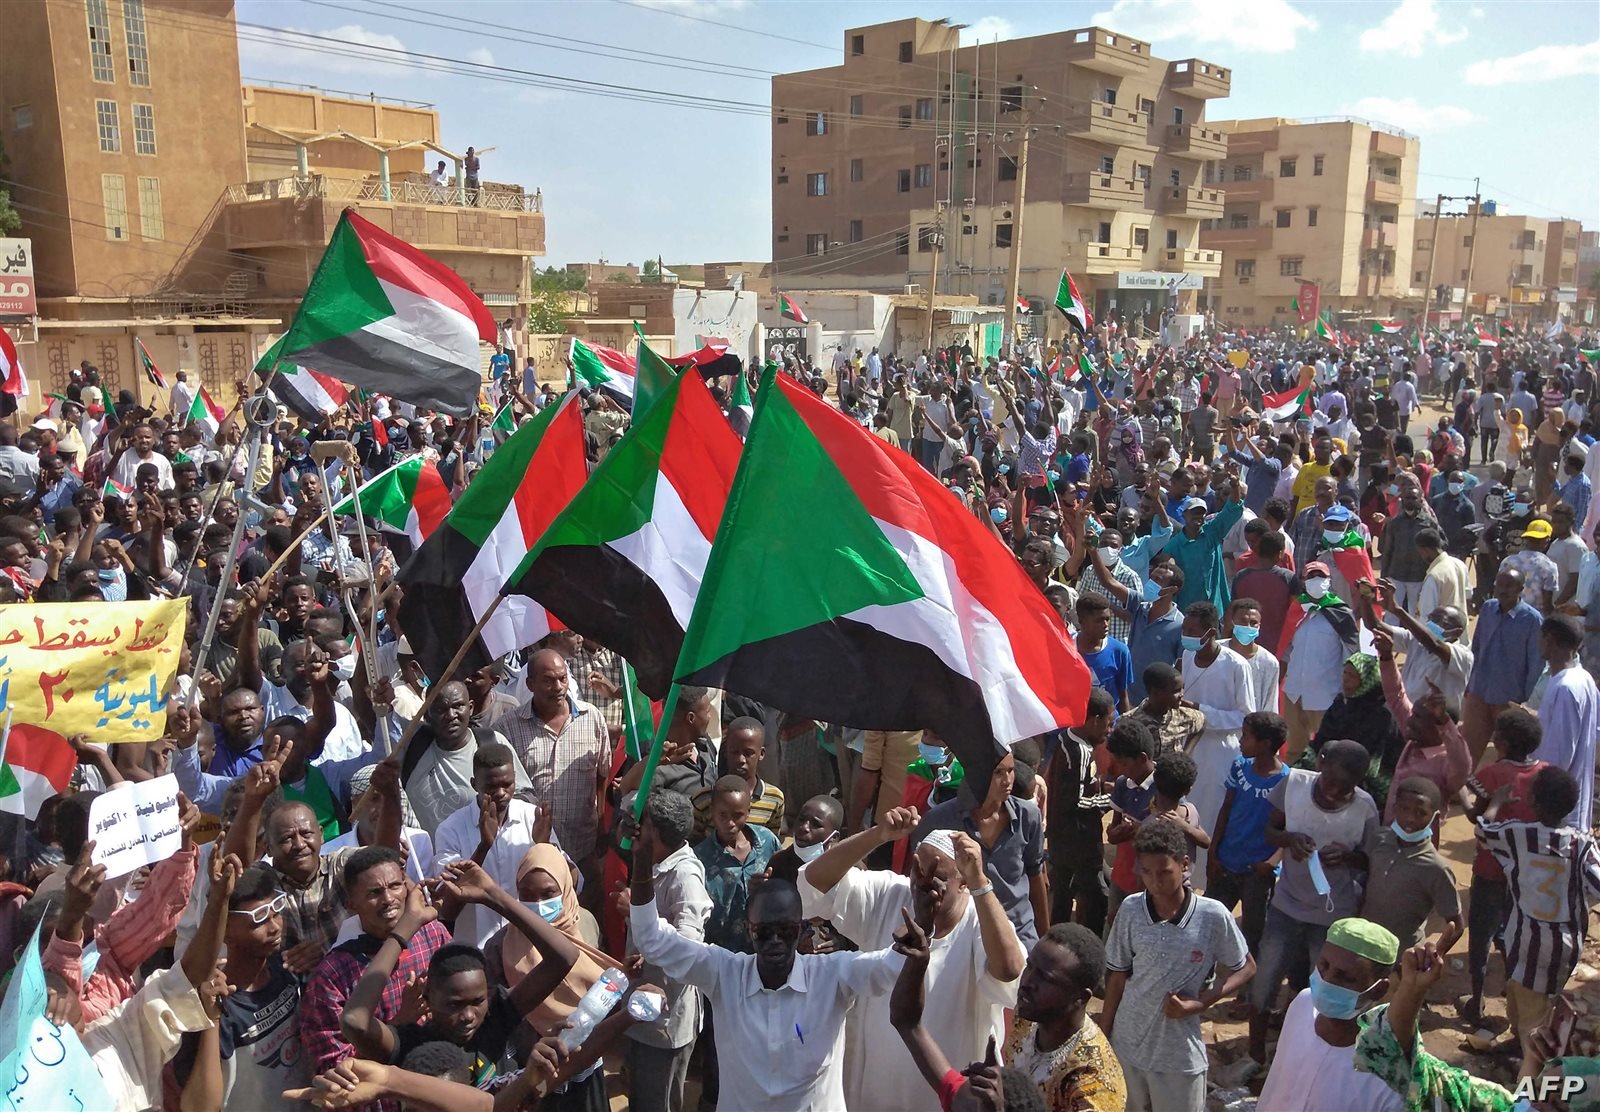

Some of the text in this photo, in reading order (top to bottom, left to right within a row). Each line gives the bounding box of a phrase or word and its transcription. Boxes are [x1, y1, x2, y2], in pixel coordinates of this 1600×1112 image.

[29, 615, 121, 657] يسقط
[1236, 769, 1274, 799] NEW YO
[135, 796, 176, 817] مليونية
[1529, 859, 1566, 921] 3
